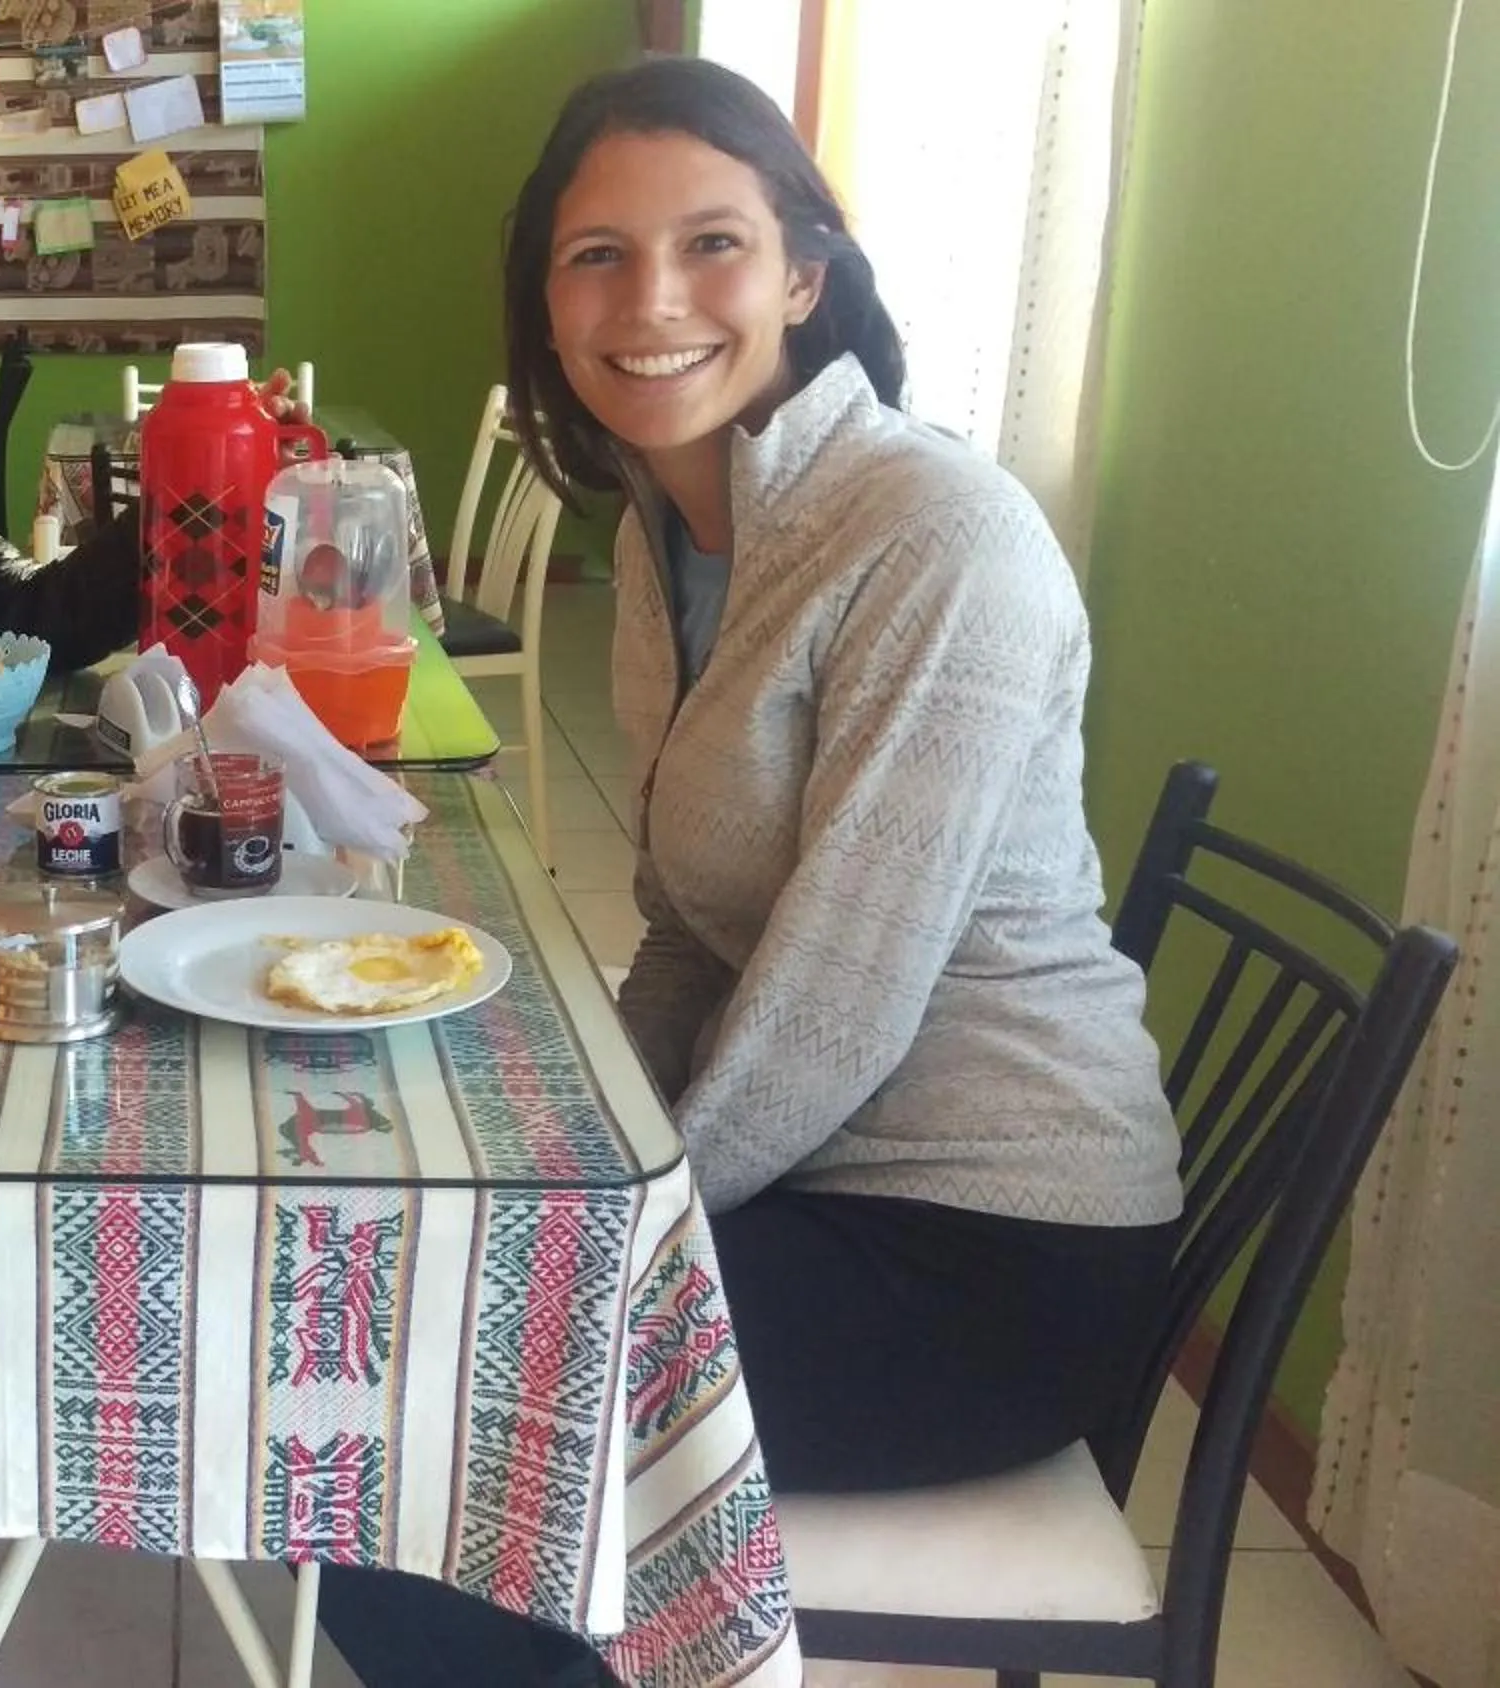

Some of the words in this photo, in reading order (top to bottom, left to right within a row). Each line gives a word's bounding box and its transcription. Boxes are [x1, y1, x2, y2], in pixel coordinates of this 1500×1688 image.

[119, 192, 138, 212] LET
[127, 196, 184, 236] MEMORY
[43, 801, 101, 823] GLORIA
[51, 848, 92, 865] LECHE
